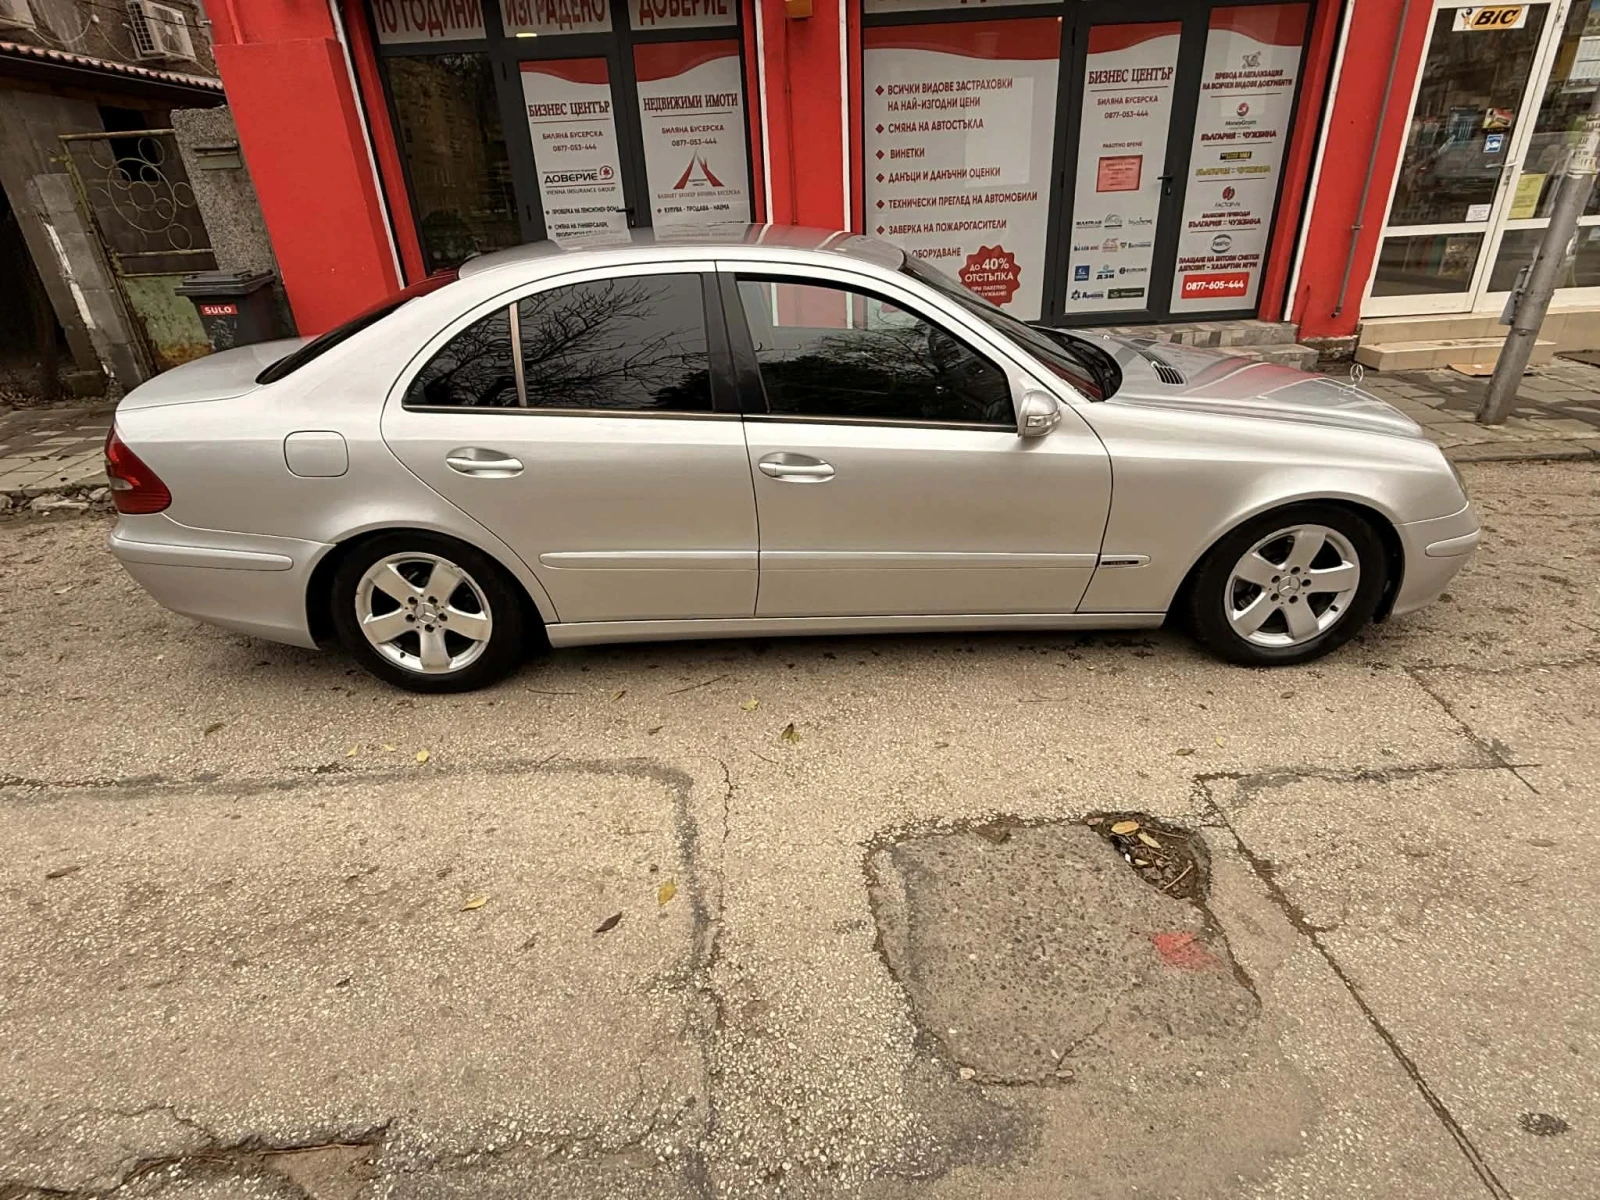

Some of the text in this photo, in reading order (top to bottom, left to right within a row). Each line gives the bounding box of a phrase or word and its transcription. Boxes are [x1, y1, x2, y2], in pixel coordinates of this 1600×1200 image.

[400, 0, 482, 37] ГОДИНИ
[1474, 9, 1519, 25] BIC
[1088, 67, 1174, 84] БИЗНЕС ЦЕНТЪР
[887, 78, 1013, 95] ВСИЧКИ ВИДОВЕ ЗАСТРАХОВКИ
[643, 93, 738, 112] НЕДВИЖИМИ ИМОТИ
[887, 97, 981, 112] НА НАЙ-ИЗГОДНИ ЦЕНИ
[1097, 95, 1158, 106] БИЛЯНА БУСЕРСКА
[528, 100, 610, 117] БИЗНЕС ЦЕНТЪР
[1104, 110, 1149, 119] 0877-053-444
[661, 124, 725, 134] БИЛЯНА БУСЕРСКА
[888, 118, 984, 133] СМЯНА НА АВТОСТЪКЛА
[542, 130, 604, 140] БИЛЯНА БУСЕРСКА
[671, 138, 717, 147] 0877-053-444
[890, 148, 925, 159] ВИНЕТКИ
[544, 172, 599, 184] ДОВЕРИЕ
[888, 167, 1001, 184] ДАНЪЦИ И ДАНЪЧНИ ОЦЕНКИ
[888, 191, 1038, 209] ТЕХНИЧЕСКИ ПРЕГЛЕД НА АВТОМОБИЛИ
[888, 219, 1007, 235] ЗАВЕРКА НА ПОЖАРОГАСИТЕЛИ
[911, 247, 961, 259] ОБОРУДВАНЕ
[969, 257, 1010, 272] ДО 40%
[964, 272, 1014, 283] ОТСТЪПКА
[1185, 280, 1245, 291] 0877-605-444
[204, 306, 232, 314] SULO
